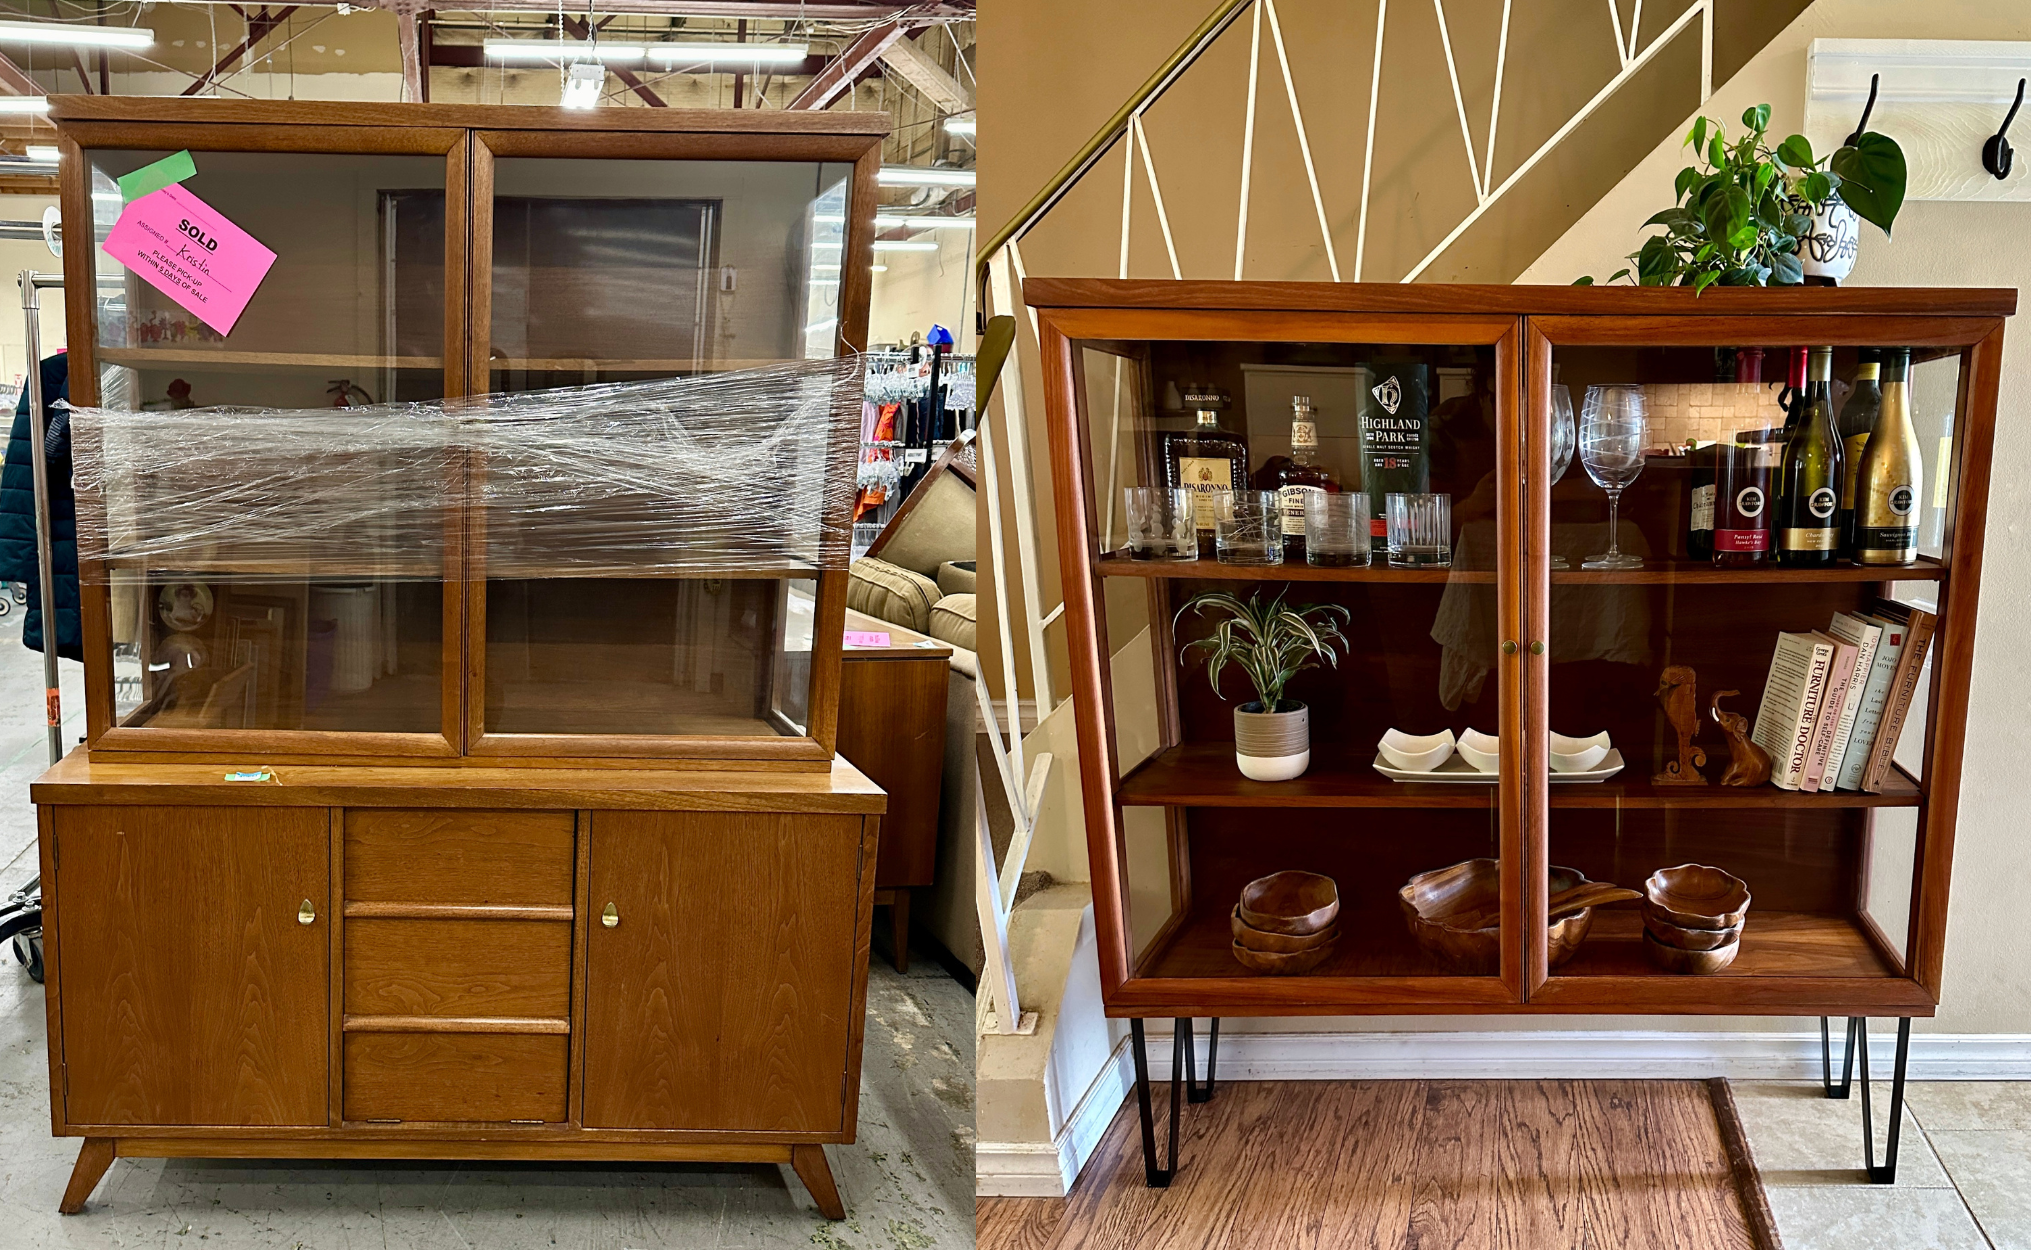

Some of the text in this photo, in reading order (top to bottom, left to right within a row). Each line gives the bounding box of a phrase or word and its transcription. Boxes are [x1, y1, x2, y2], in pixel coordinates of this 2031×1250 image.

[137, 220, 165, 242] ASSIGNED
[178, 218, 218, 251] SOLD
[137, 249, 160, 269] WITHIN
[164, 269, 182, 285] DAYS
[181, 281, 191, 290] OF
[190, 288, 208, 304] SALE
[152, 250, 203, 287] PLEASE PICK-UP
[1185, 394, 1220, 402] DISARONNO
[1361, 416, 1421, 430] HIGHLAND
[1375, 431, 1406, 443] PARK
[1384, 457, 1397, 469] 18
[1850, 642, 1869, 690] DAN HARRIS
[1859, 651, 1873, 685] HAPPIER
[1877, 662, 1897, 671] MOYES
[1882, 655, 1897, 663] JOJO
[1802, 660, 1826, 723] FURNITURE
[1839, 678, 1847, 691] THE
[1877, 638, 1927, 770] THE FURNITURE BIBLE
[1815, 687, 1839, 755] GUIDE TO SELF-CARE
[1790, 726, 1810, 773] DOCTOR
[1817, 730, 1832, 767] DEFINITIVE
